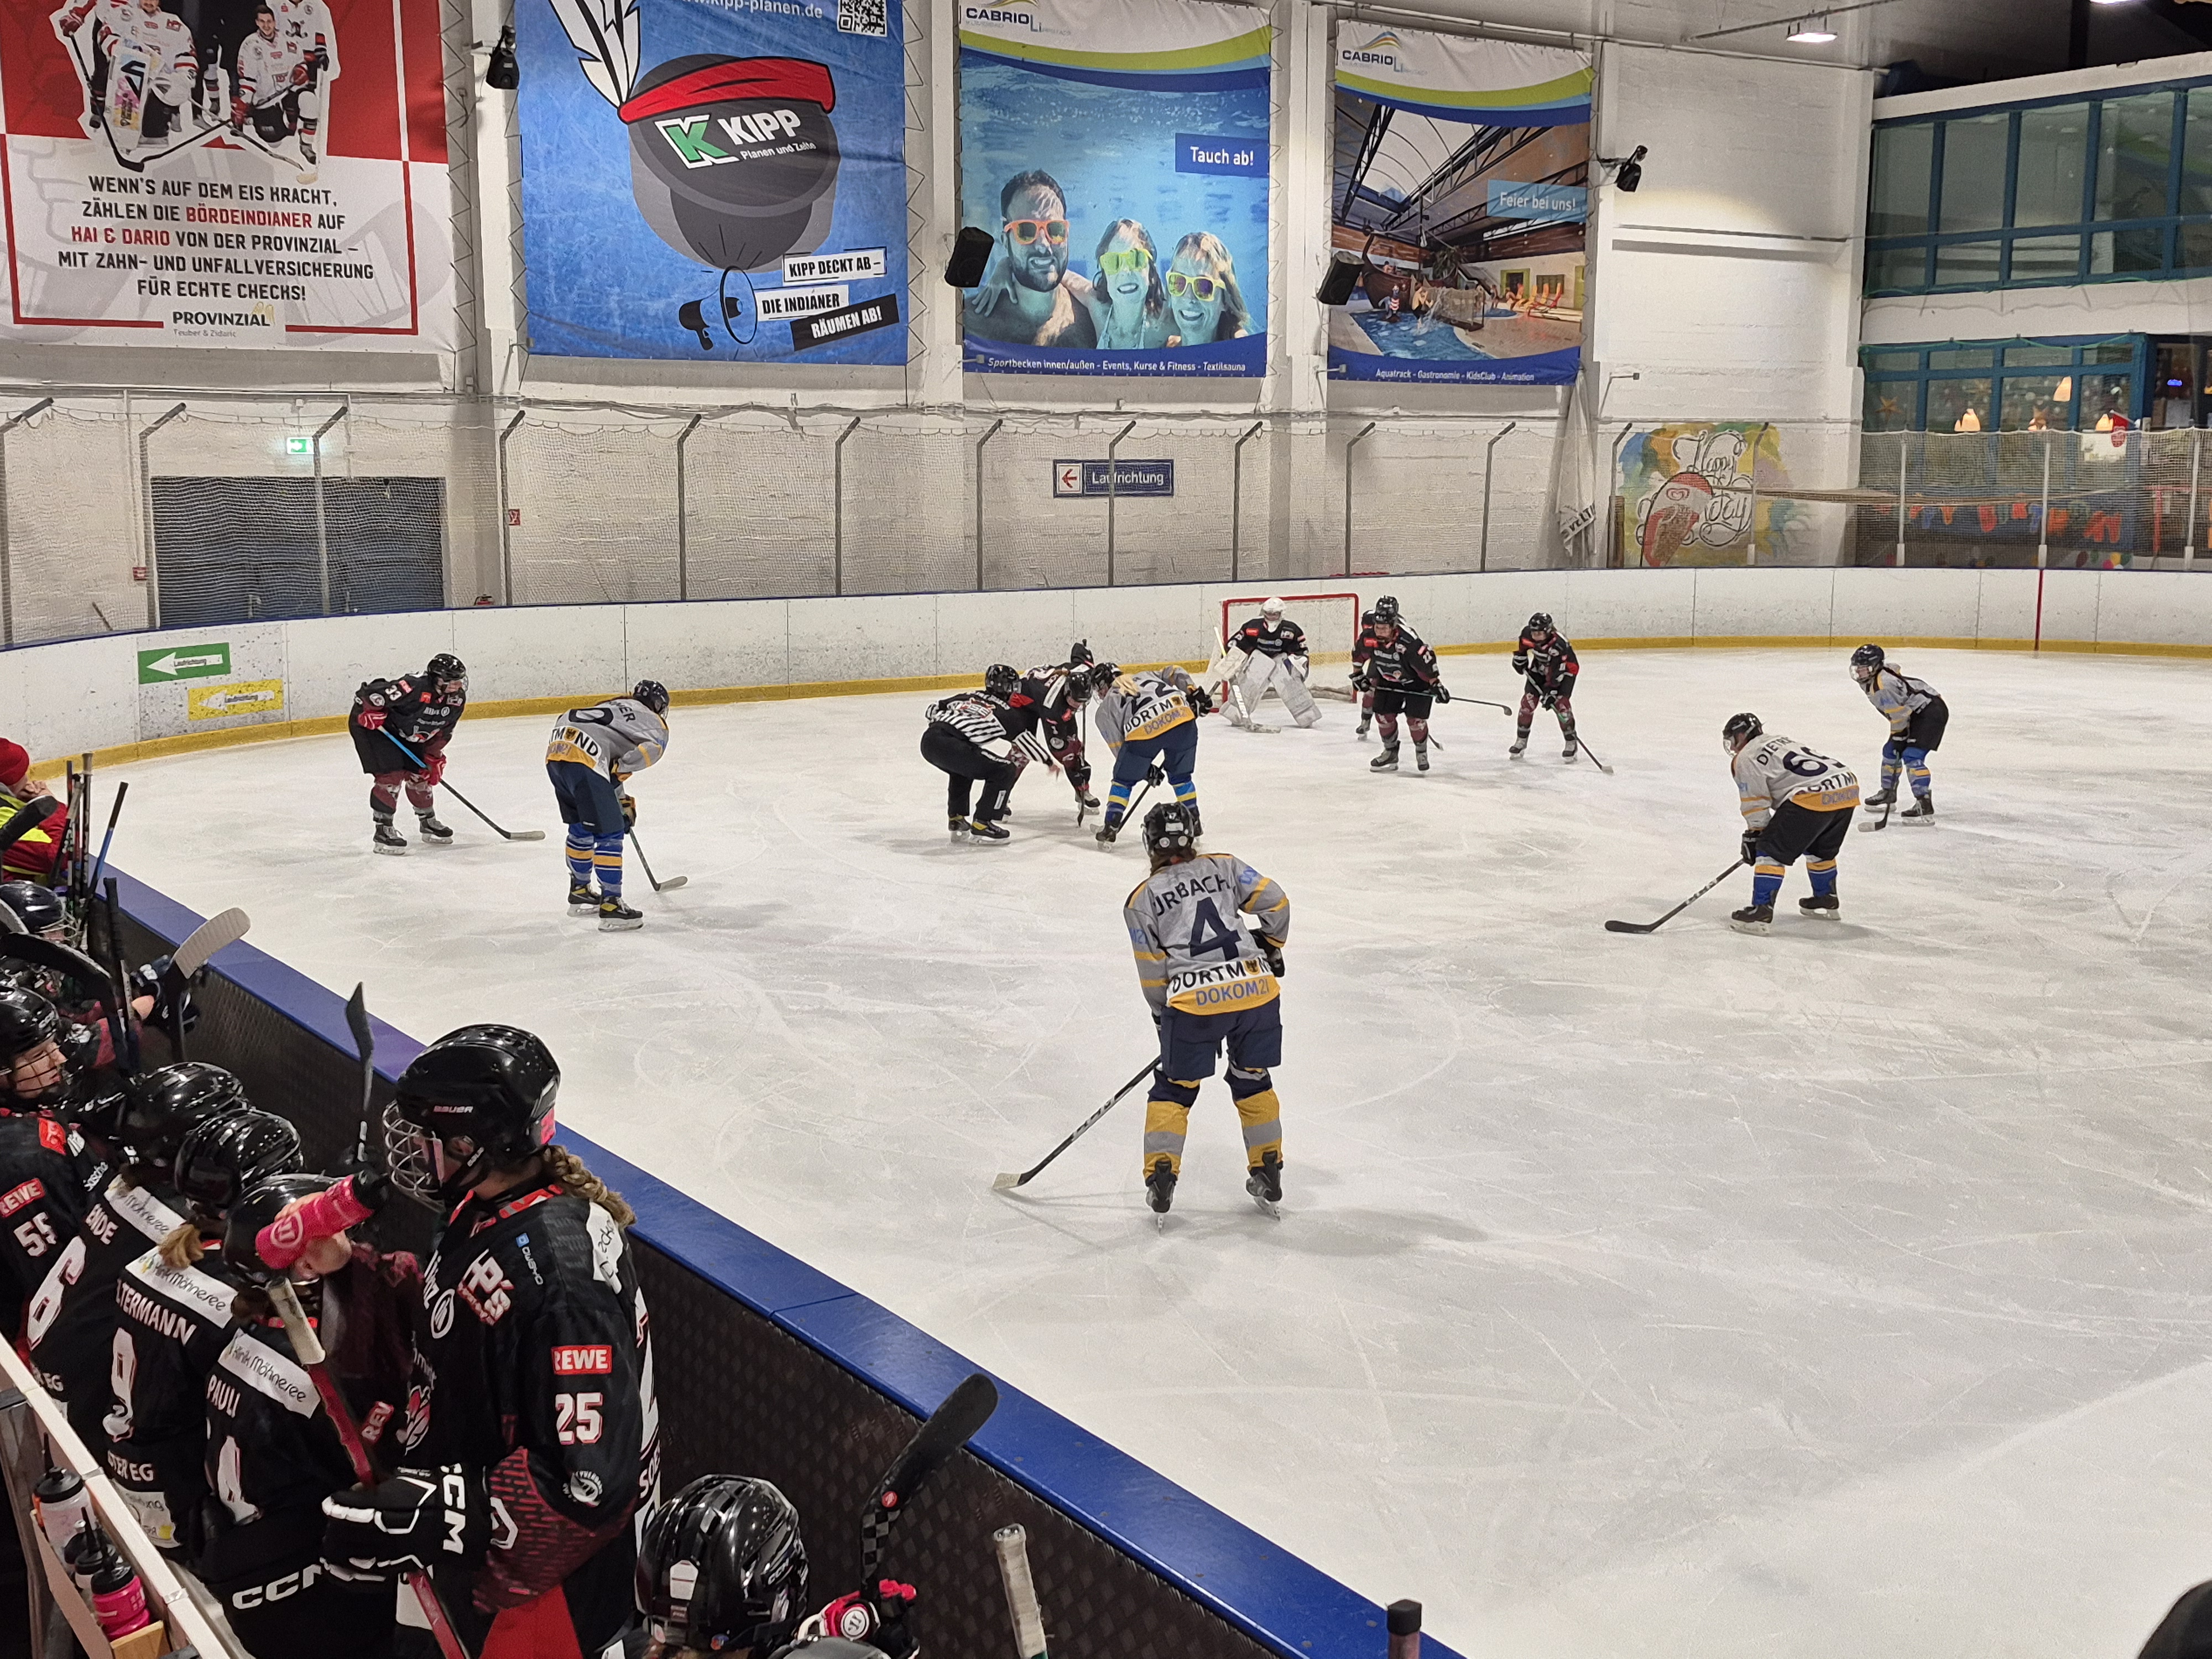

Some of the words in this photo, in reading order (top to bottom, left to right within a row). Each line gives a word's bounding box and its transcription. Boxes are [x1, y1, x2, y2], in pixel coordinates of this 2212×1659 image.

[717, 109, 801, 145] KIPP
[740, 147, 776, 160] Planen
[776, 144, 794, 155] und
[1190, 146, 1229, 164] Tauch
[1233, 150, 1254, 166] ab!
[88, 175, 155, 195] WENN'S
[162, 180, 191, 196] AUF
[198, 182, 233, 200] DEM
[239, 184, 264, 201] EIS
[82, 197, 147, 220] ZÄHLEN
[154, 205, 180, 221] DIE
[186, 203, 312, 228] BÖRDEINDIANER
[317, 214, 346, 229] AUF
[1500, 192, 1530, 207] Feier
[1532, 194, 1548, 209] bei
[1552, 198, 1575, 211] uns!
[122, 228, 170, 246] DARIO
[175, 231, 208, 248] VON
[213, 232, 246, 250] DER
[252, 234, 342, 254] PROVINZIAL
[58, 251, 89, 268] MIT
[95, 252, 148, 270] ZAHN-
[153, 255, 186, 272] UND
[192, 257, 374, 279] UNFALLVERSICHERUNG
[789, 262, 816, 277] KIPP
[818, 258, 853, 274] DECKT
[857, 257, 871, 271] AB
[137, 275, 171, 296] FÜR
[176, 281, 232, 299] ECHTE
[762, 299, 782, 315] DIE
[785, 293, 840, 312] INDIANER
[173, 311, 270, 326] PROVINZIAL
[811, 312, 860, 338] RÄUMEN
[862, 305, 883, 324] AB!
[988, 358, 1042, 369] Sportbecken
[1103, 361, 1132, 371] Events,
[1134, 361, 1157, 371] Kurse
[1160, 362, 1165, 371] &
[1167, 361, 1196, 371] Fitness
[1375, 368, 1411, 378] Aquatrack
[1190, 897, 1243, 961] 4
[554, 1349, 608, 1371] REWE
[206, 1374, 241, 1418] PAULI
[555, 1392, 603, 1444] 25
